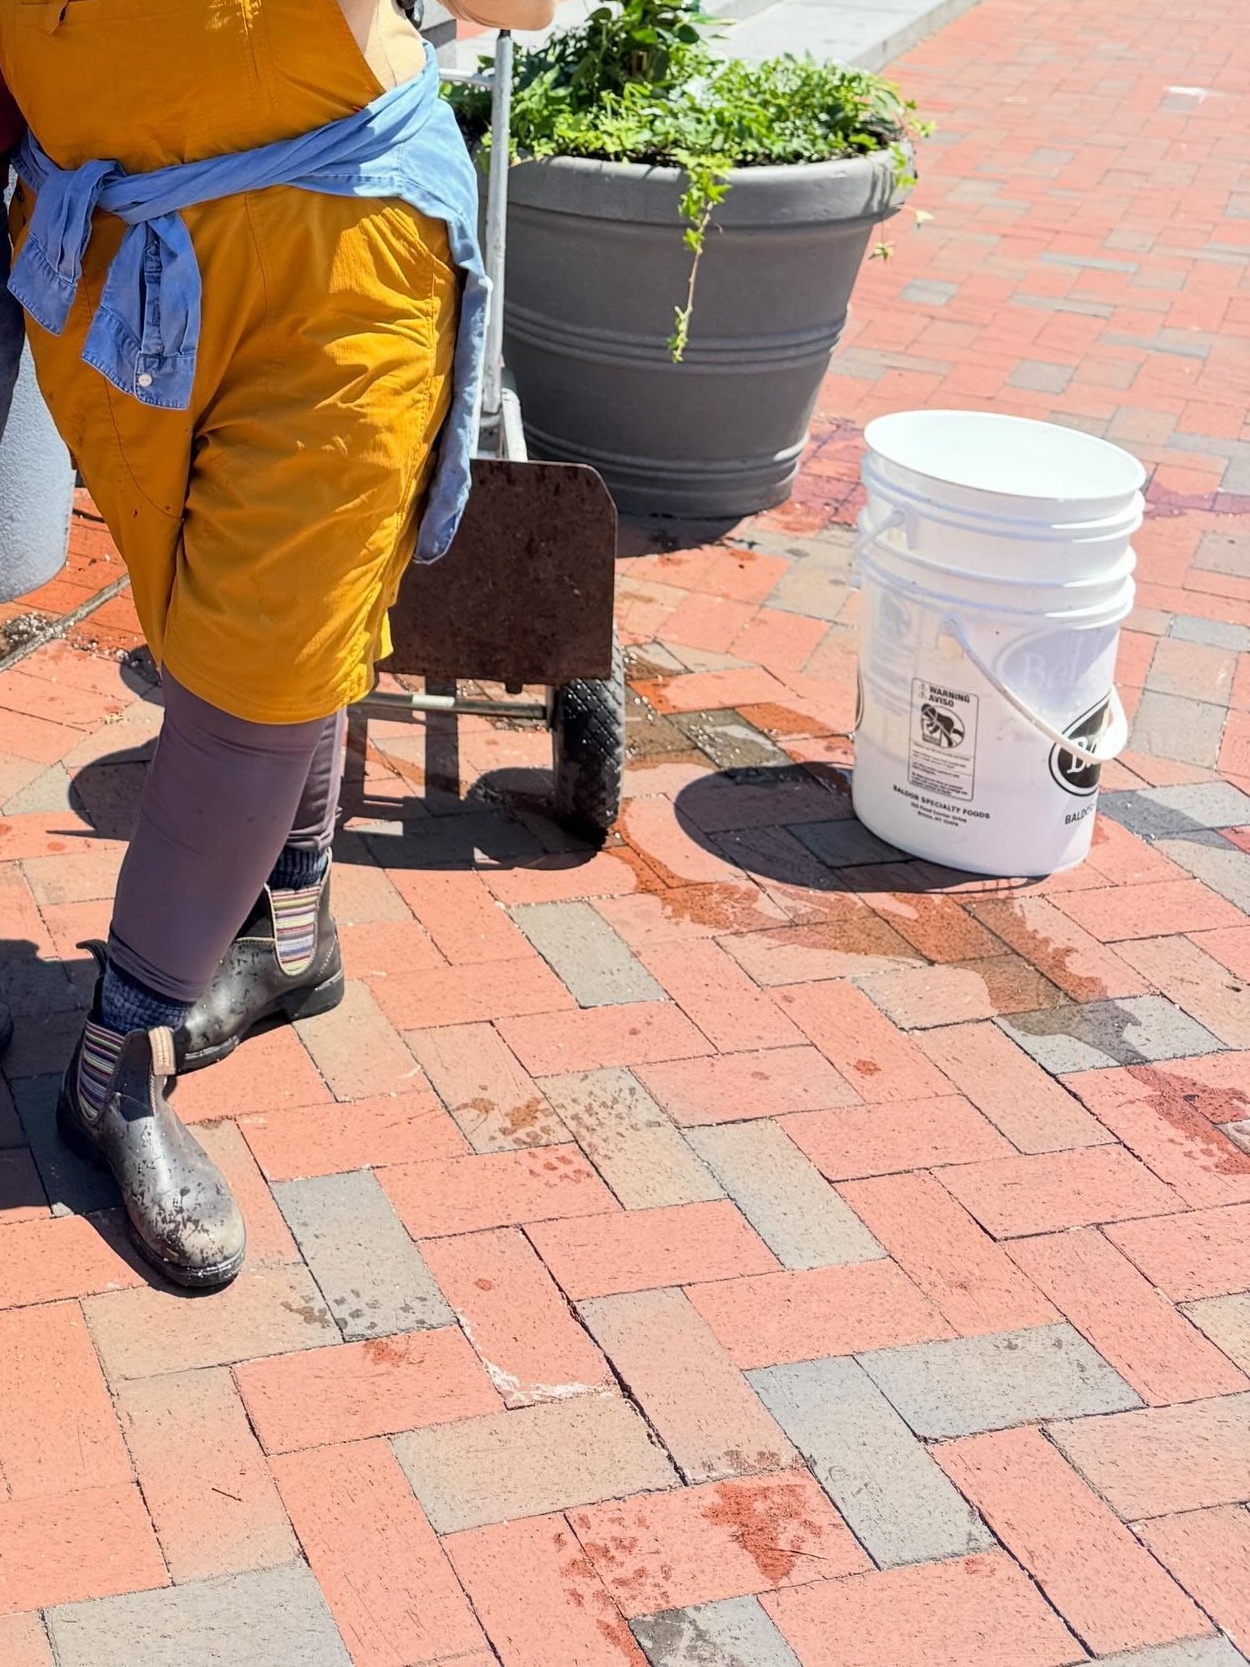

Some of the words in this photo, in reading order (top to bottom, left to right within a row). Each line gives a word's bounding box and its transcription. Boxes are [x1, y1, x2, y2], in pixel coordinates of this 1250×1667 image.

[928, 694, 955, 708] AVISO
[929, 685, 971, 703] WARNING
[892, 784, 919, 801] BALDOR
[920, 796, 961, 813] SPECIALTY
[962, 808, 990, 819] FOODS
